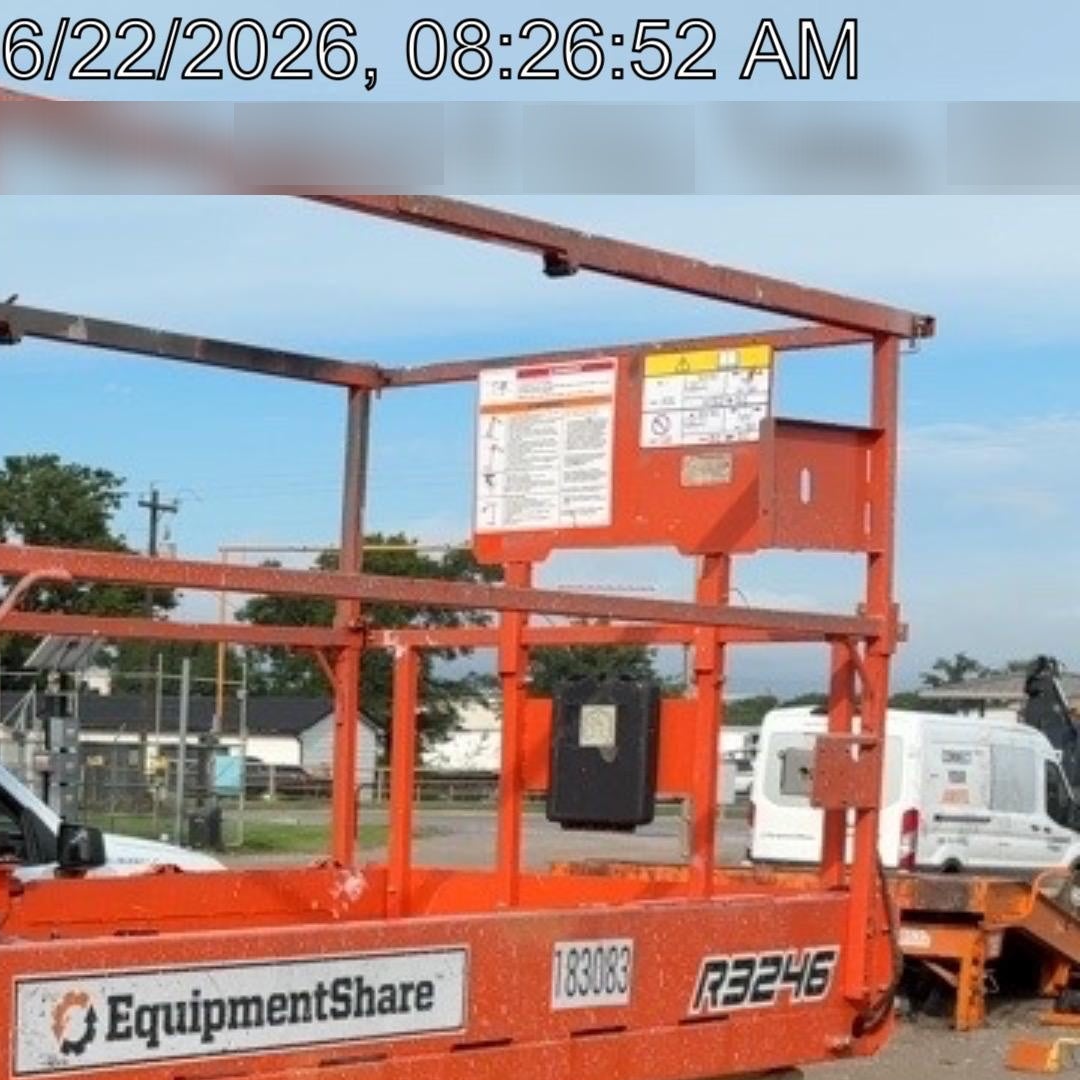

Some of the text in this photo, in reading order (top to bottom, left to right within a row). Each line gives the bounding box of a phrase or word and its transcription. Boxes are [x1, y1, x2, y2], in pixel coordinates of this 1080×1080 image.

[554, 945, 630, 997] 183083
[692, 948, 836, 1010] R3246
[105, 975, 435, 1049] EquipmentShare
